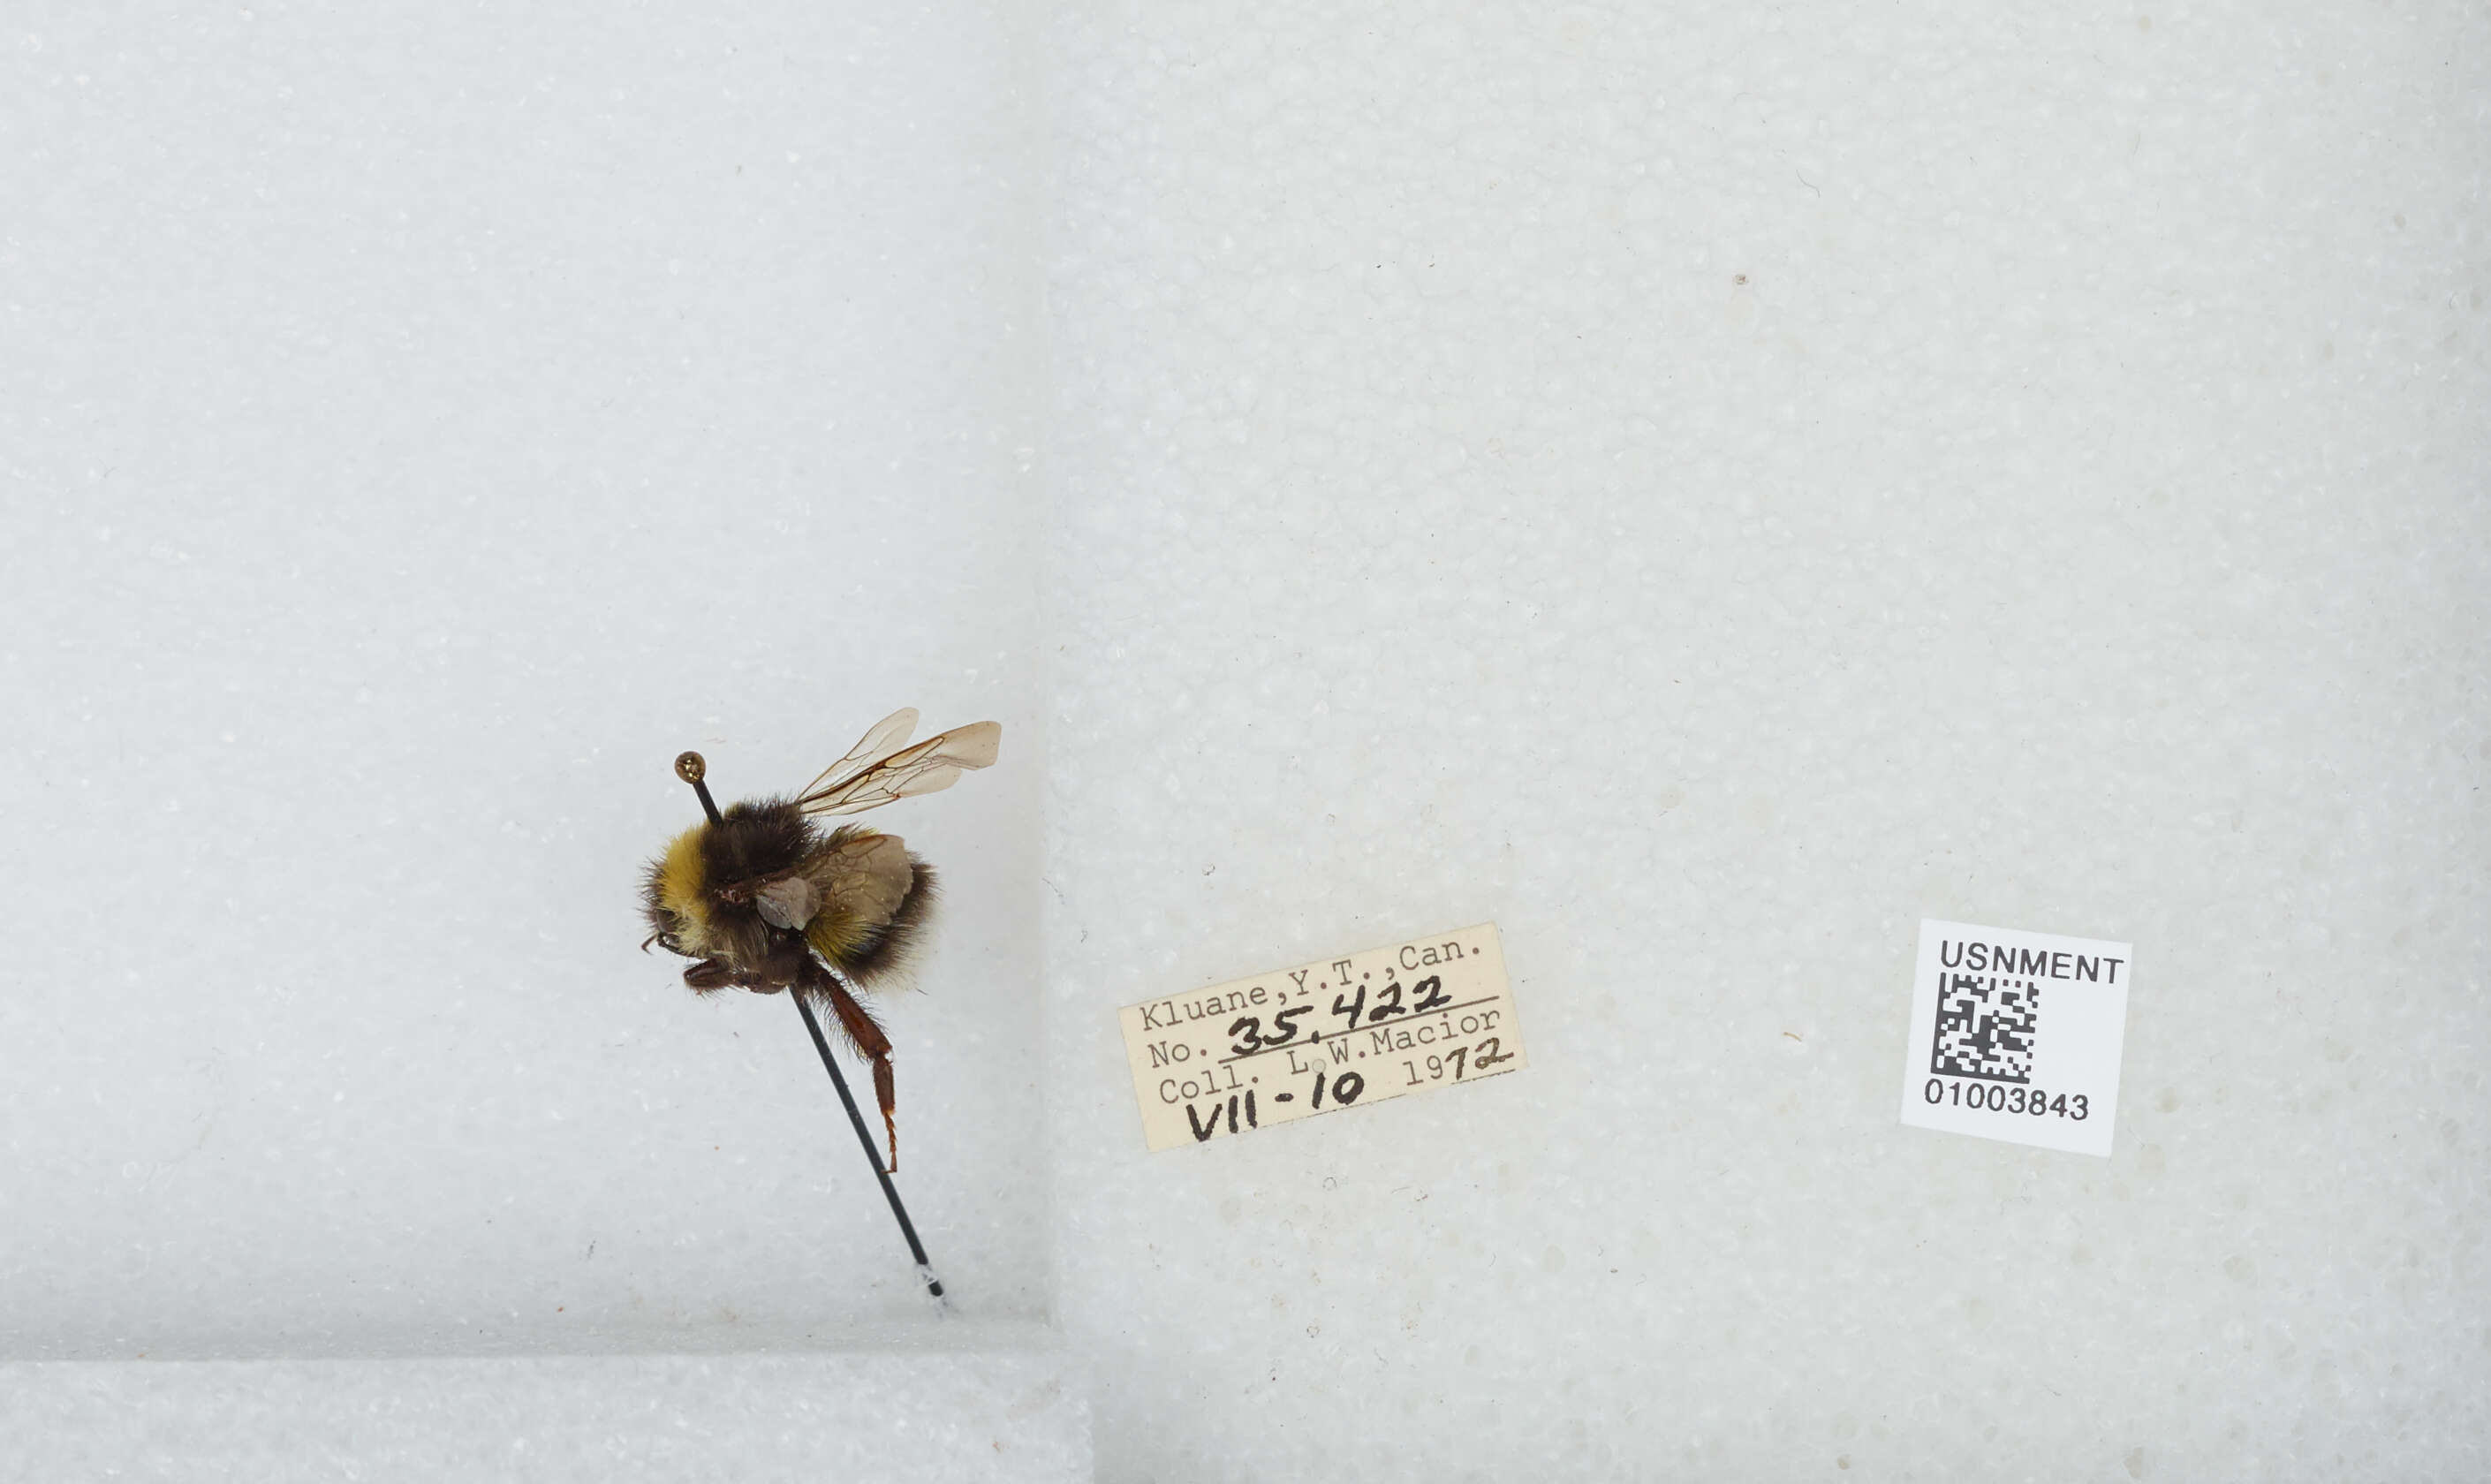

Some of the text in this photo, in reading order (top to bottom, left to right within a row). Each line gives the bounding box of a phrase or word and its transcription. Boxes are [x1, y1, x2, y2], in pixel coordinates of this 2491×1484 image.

[1940, 940, 2124, 984] USNMENT
[1149, 1041, 1208, 1069] No.
[1160, 1008, 1501, 1104] Coll. LW.Macior
[1404, 1037, 1515, 1086] 1972
[1924, 1078, 2089, 1121] 01003843
